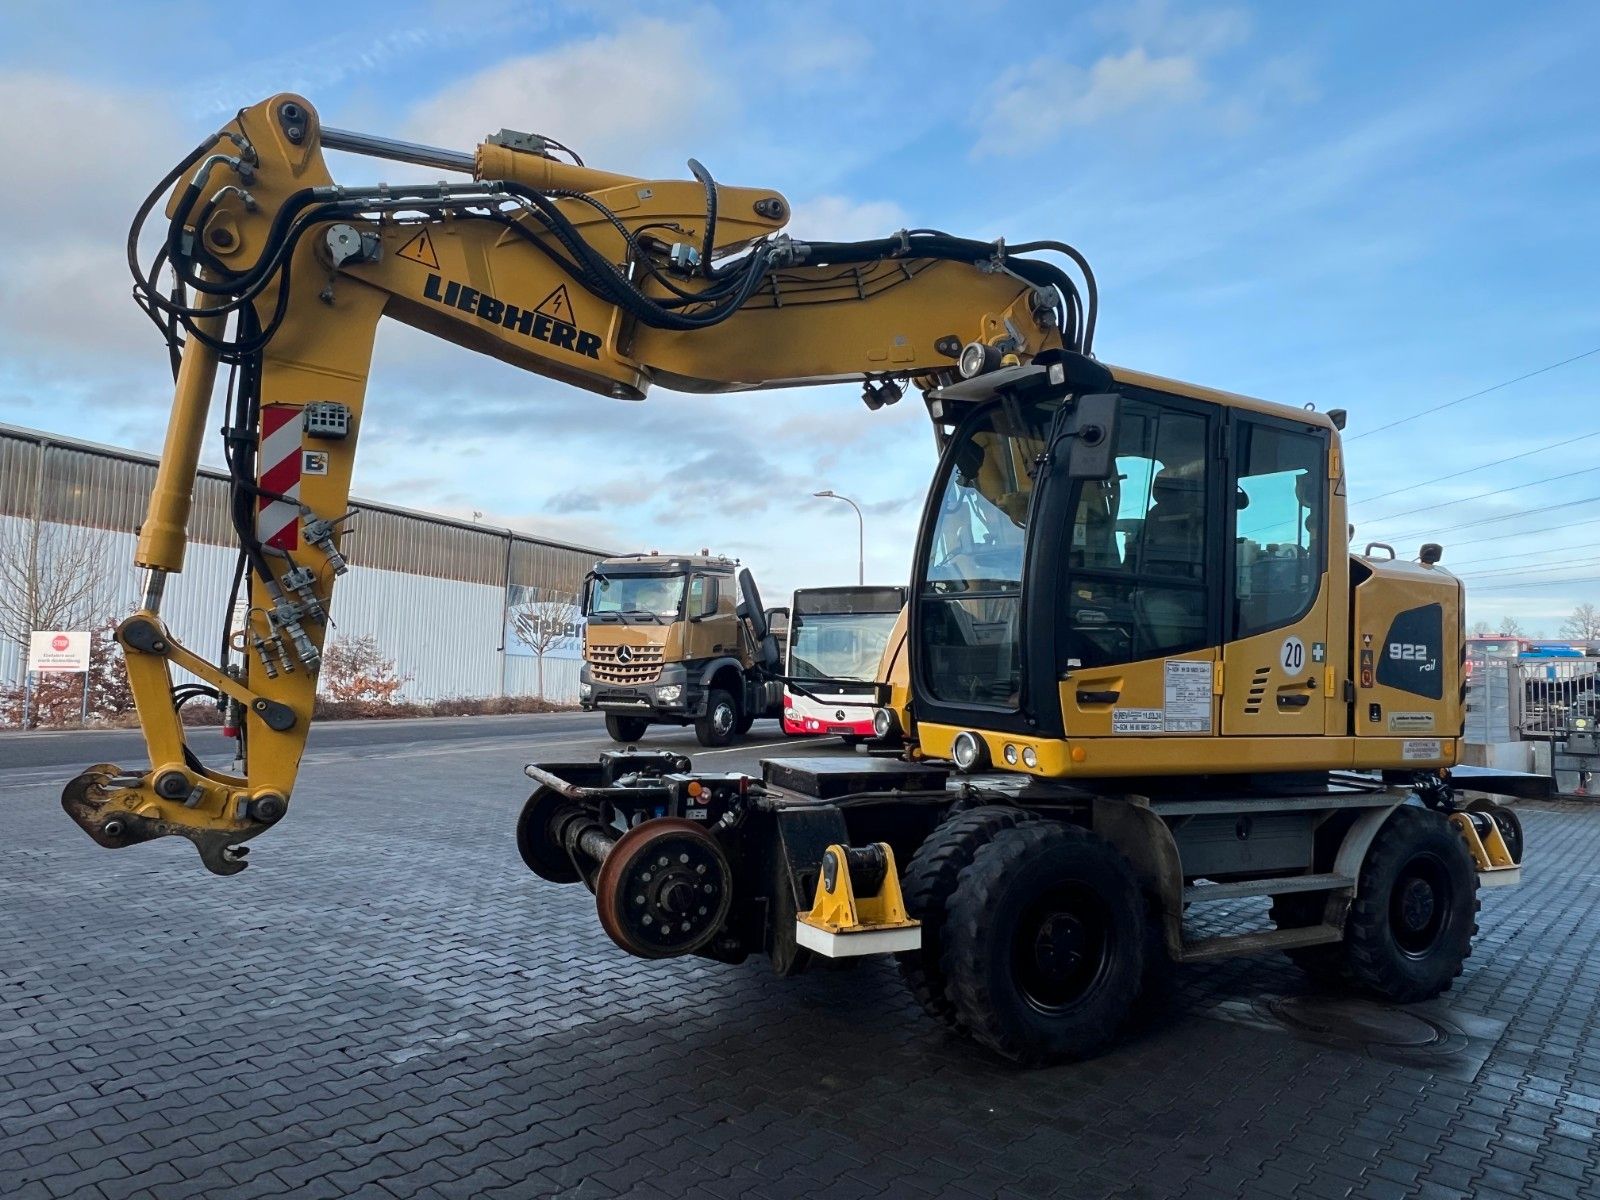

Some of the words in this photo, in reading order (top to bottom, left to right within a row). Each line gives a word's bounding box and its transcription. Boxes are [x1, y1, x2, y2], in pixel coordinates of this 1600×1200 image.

[423, 273, 602, 360] LIEBHERR
[1285, 642, 1301, 667] 20
[1390, 643, 1427, 660] 922
[1419, 658, 1436, 671] rail
